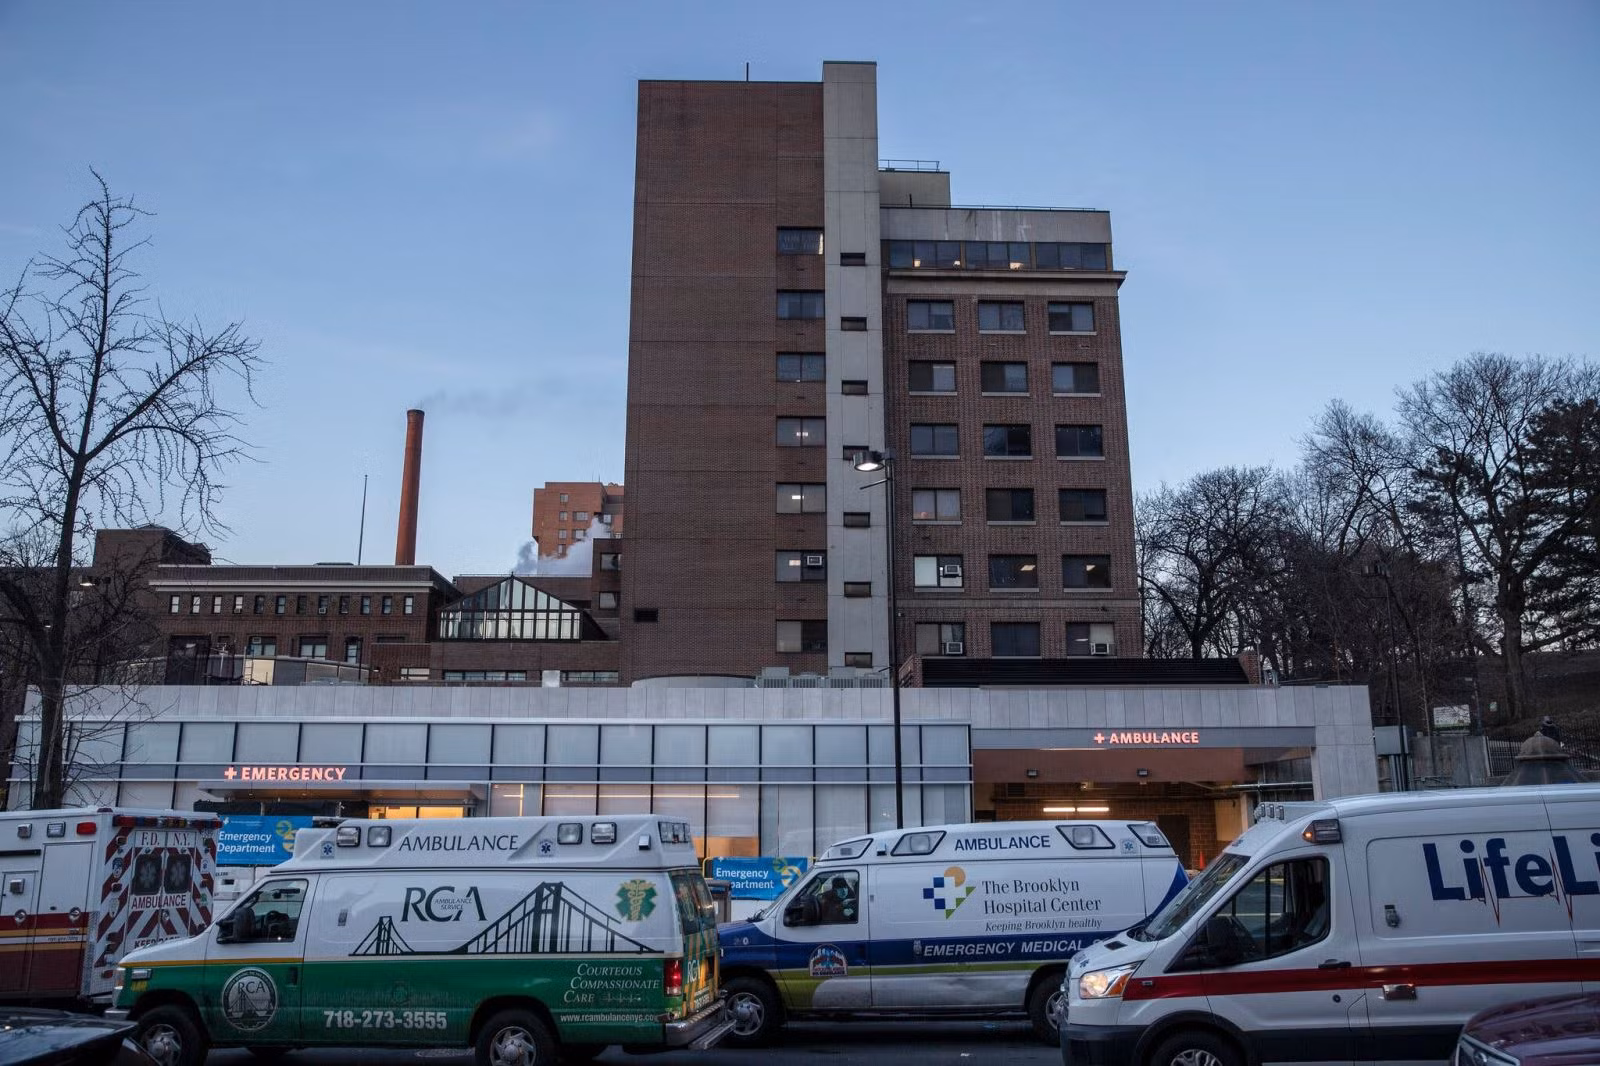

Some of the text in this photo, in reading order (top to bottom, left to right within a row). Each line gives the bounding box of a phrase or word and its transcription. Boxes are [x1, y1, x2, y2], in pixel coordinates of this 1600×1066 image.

[1109, 732, 1199, 744] AMBULANCE
[241, 767, 346, 780] EMERGENCY
[218, 831, 272, 843] Emergency
[398, 835, 519, 851] AMBULANCE
[954, 835, 1051, 851] AMBULANCE
[217, 843, 275, 854] Department
[716, 868, 768, 879] Emergency
[730, 880, 774, 889] partment
[982, 878, 1080, 895] The Brooklyn
[131, 894, 187, 910] AMBULANCE
[400, 885, 488, 923] RCA
[984, 898, 1102, 916] Hospital Center
[985, 918, 1102, 932] Keeping Brooklyn healthy
[923, 941, 1015, 957] EMERGENCY
[1021, 938, 1084, 954] MEDICAL
[577, 963, 643, 976] COURTEOUS
[238, 981, 266, 994] RCA
[570, 976, 661, 989] COMPASSIONATE
[563, 990, 595, 1003] CARE
[323, 1010, 448, 1029] 718-273-3555
[560, 1012, 657, 1023] www.rcambulancenyc.co
